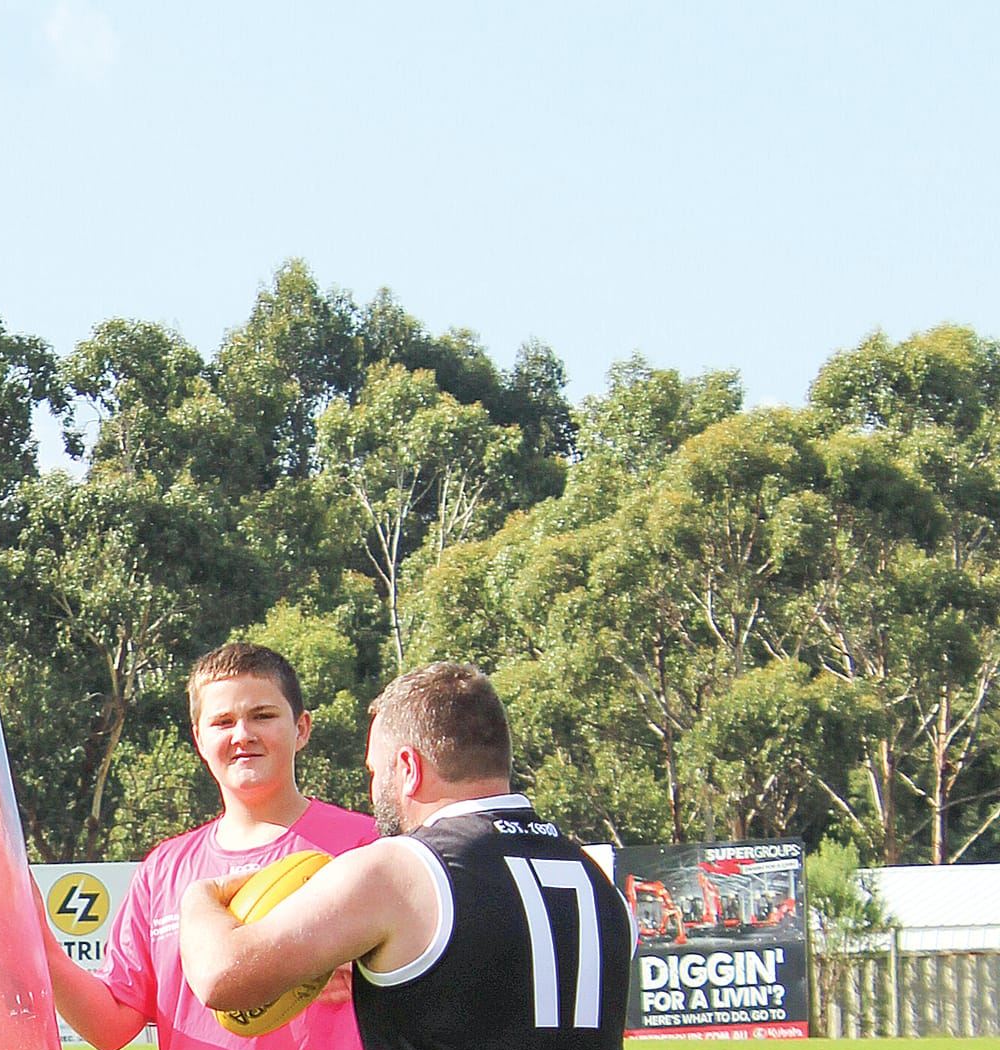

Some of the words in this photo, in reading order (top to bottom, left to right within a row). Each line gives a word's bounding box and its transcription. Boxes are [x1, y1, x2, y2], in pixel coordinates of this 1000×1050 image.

[493, 819, 528, 833] EST.
[705, 844, 801, 860] SUPERGROUPS
[62, 941, 103, 961] TRI
[504, 855, 600, 1029] 17
[640, 948, 785, 991] DIGGIN'
[643, 990, 685, 1012] FOR
[690, 989, 709, 1010] A
[712, 984, 786, 1009] LIVIN'?
[644, 1014, 681, 1026] HERE'S
[682, 1012, 714, 1025] WHAT
[715, 1011, 731, 1023] TO
[752, 1010, 769, 1020] GO
[770, 1009, 786, 1020] TO
